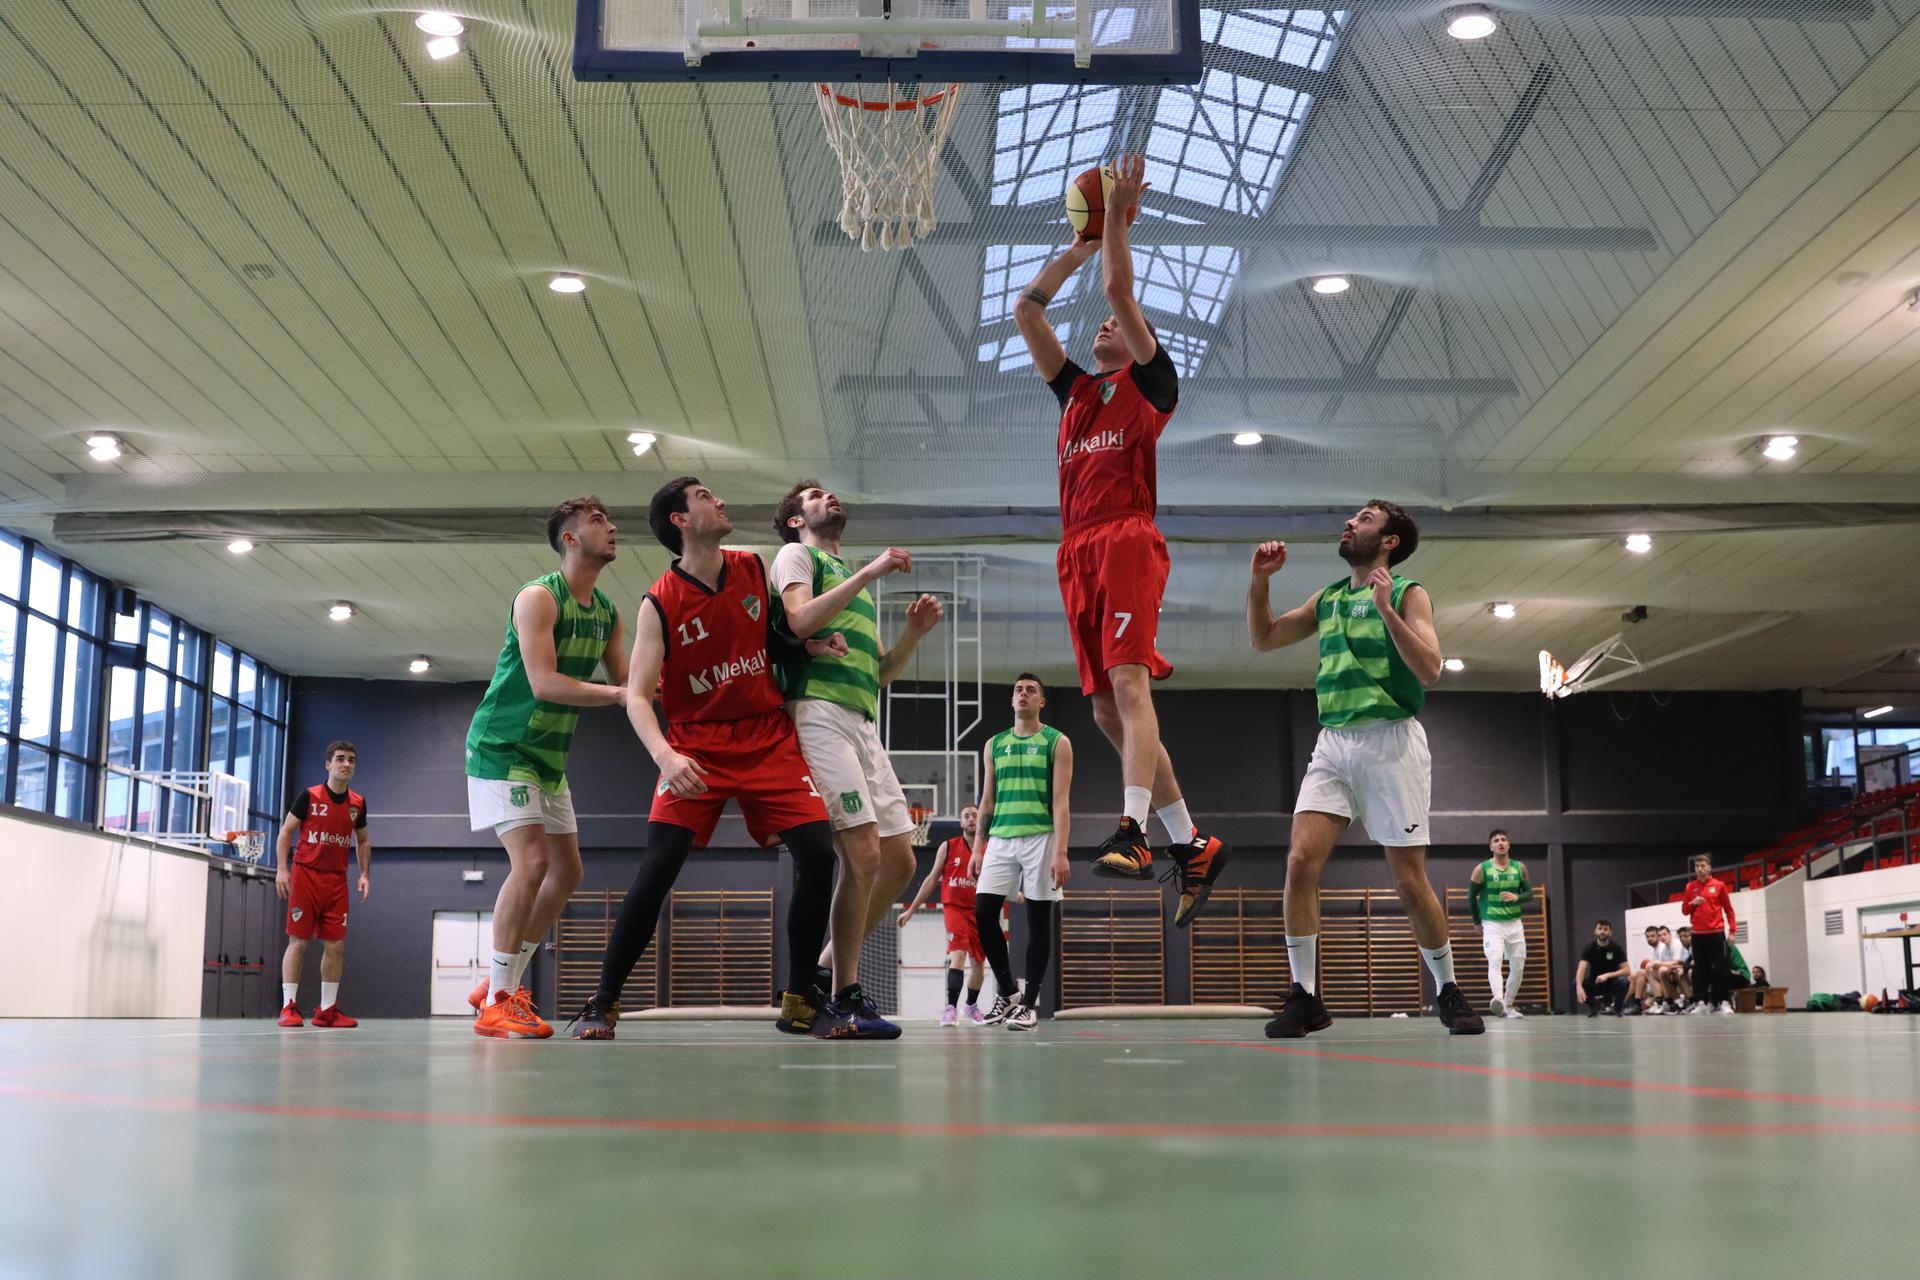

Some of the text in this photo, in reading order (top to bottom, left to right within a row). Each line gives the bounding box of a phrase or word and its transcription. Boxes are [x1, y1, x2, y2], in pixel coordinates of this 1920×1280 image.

[677, 616, 709, 647] 11
[1114, 611, 1132, 639] 7
[1004, 744, 1011, 757] 4
[311, 803, 328, 816] 12
[954, 857, 961, 867] 9
